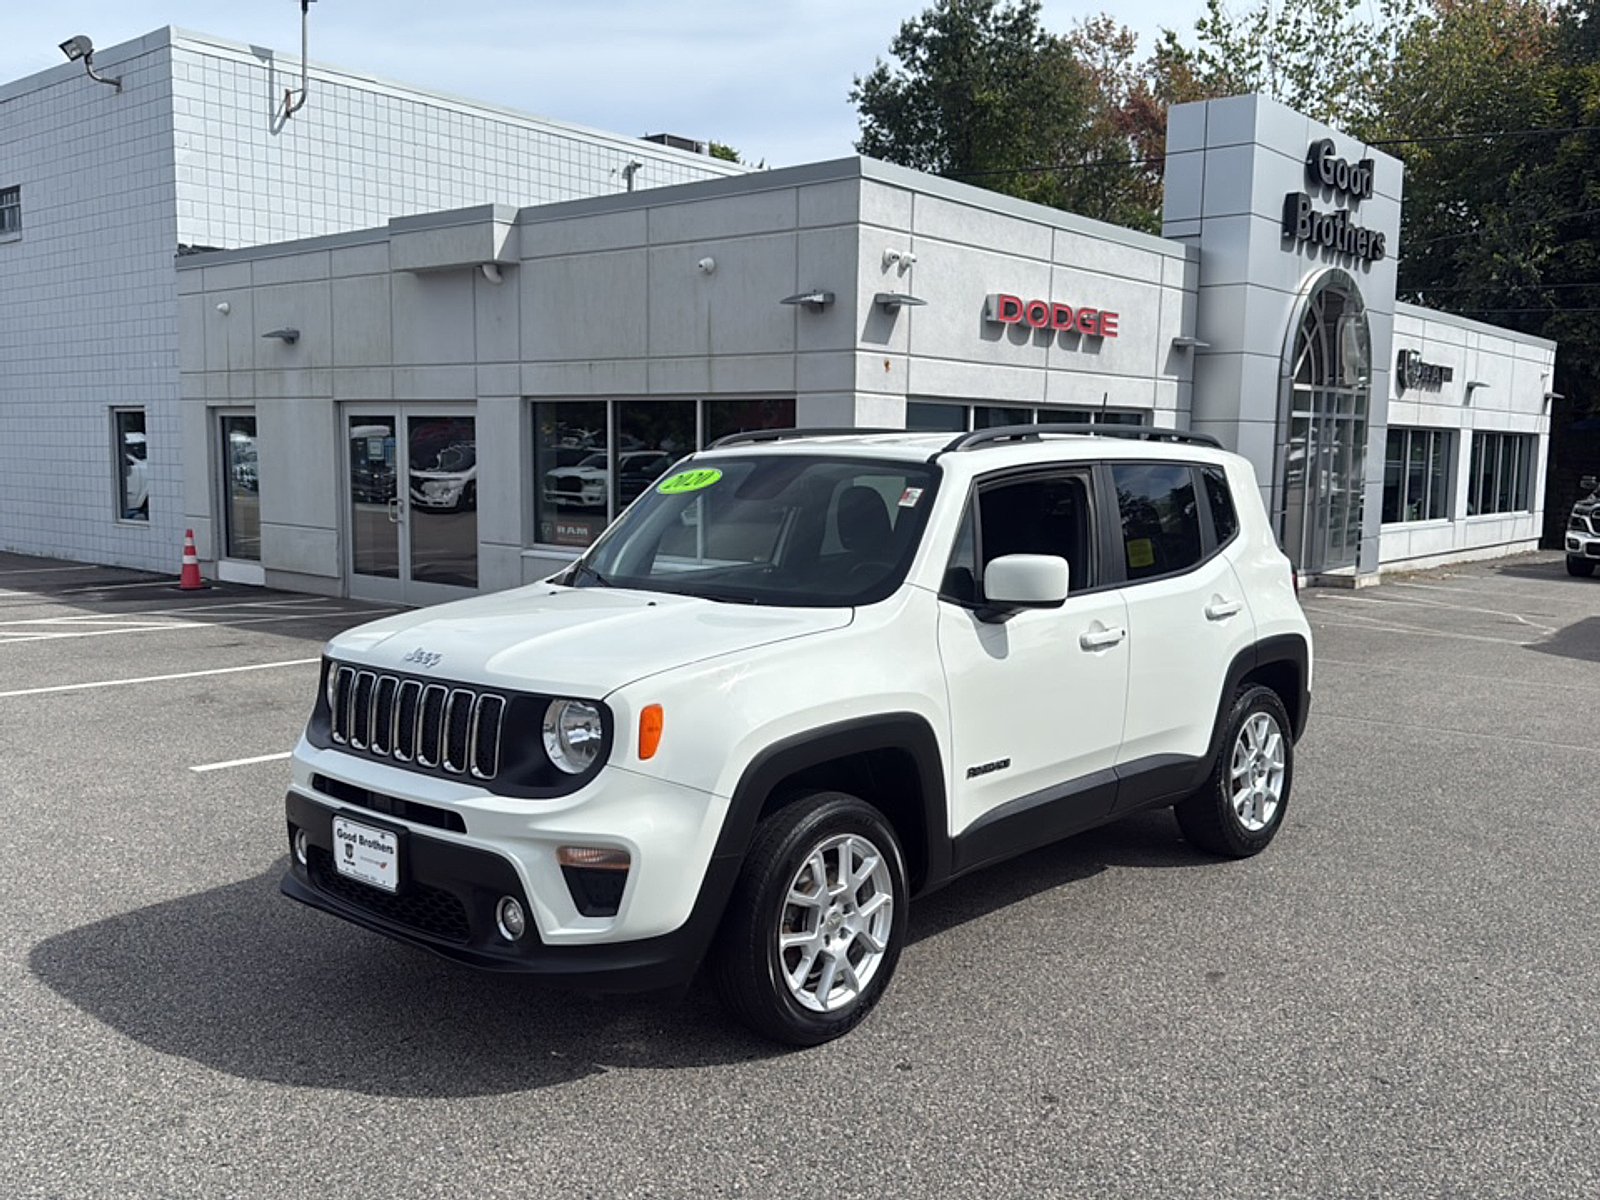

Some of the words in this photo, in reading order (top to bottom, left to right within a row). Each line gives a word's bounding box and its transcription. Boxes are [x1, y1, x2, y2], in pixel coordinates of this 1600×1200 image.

[1309, 138, 1375, 200] Good
[1288, 191, 1386, 261] Brothers
[993, 293, 1119, 338] DODGE
[557, 525, 588, 536] RAM
[404, 647, 442, 669] Jeep
[337, 828, 357, 843] Good
[359, 834, 394, 855] Brothers
